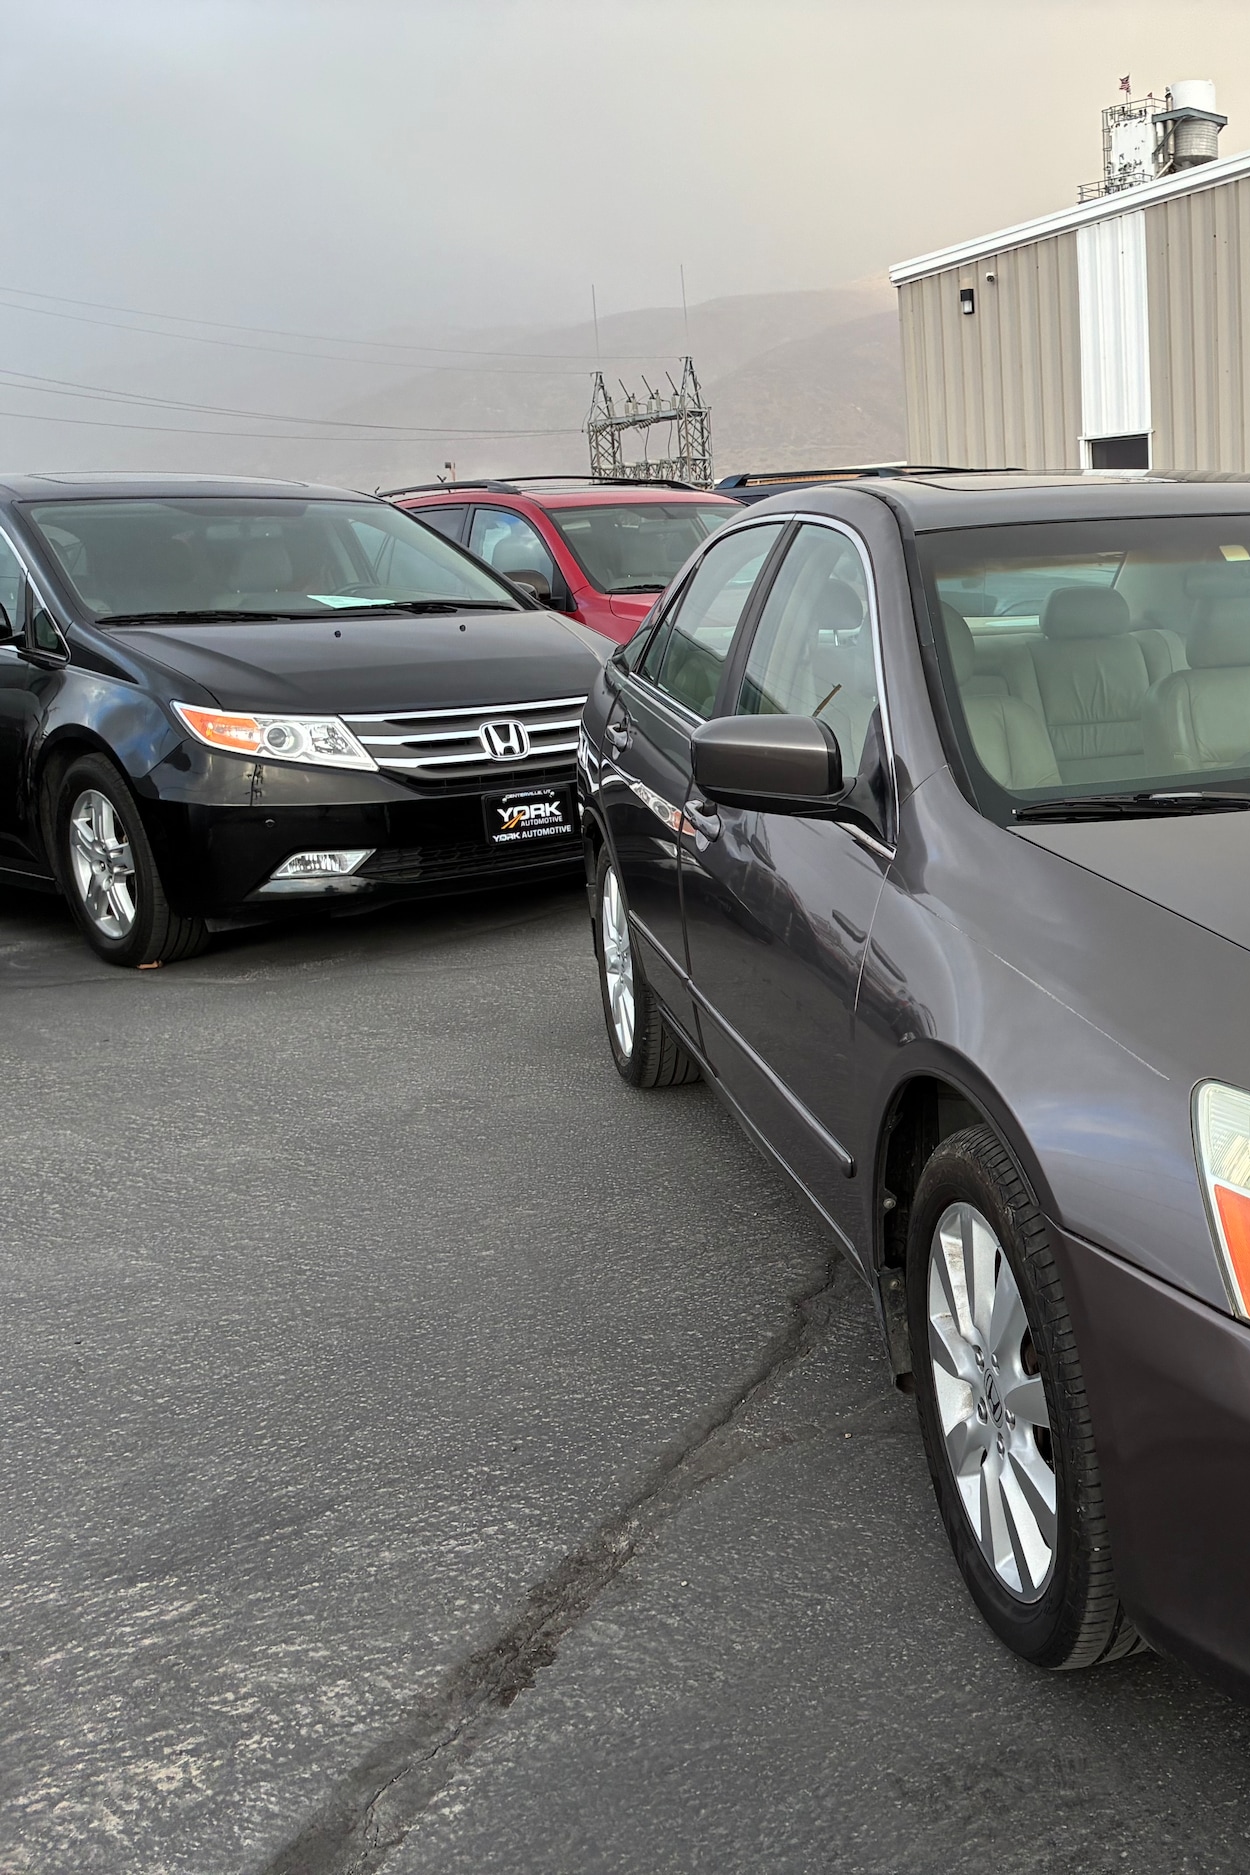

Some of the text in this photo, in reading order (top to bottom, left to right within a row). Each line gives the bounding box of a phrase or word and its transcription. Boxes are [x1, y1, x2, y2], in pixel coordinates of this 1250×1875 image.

[497, 801, 561, 822] YORK
[520, 815, 563, 827] AUTOMOTIVE
[492, 824, 572, 842] YORK AUTOMOTIVE
